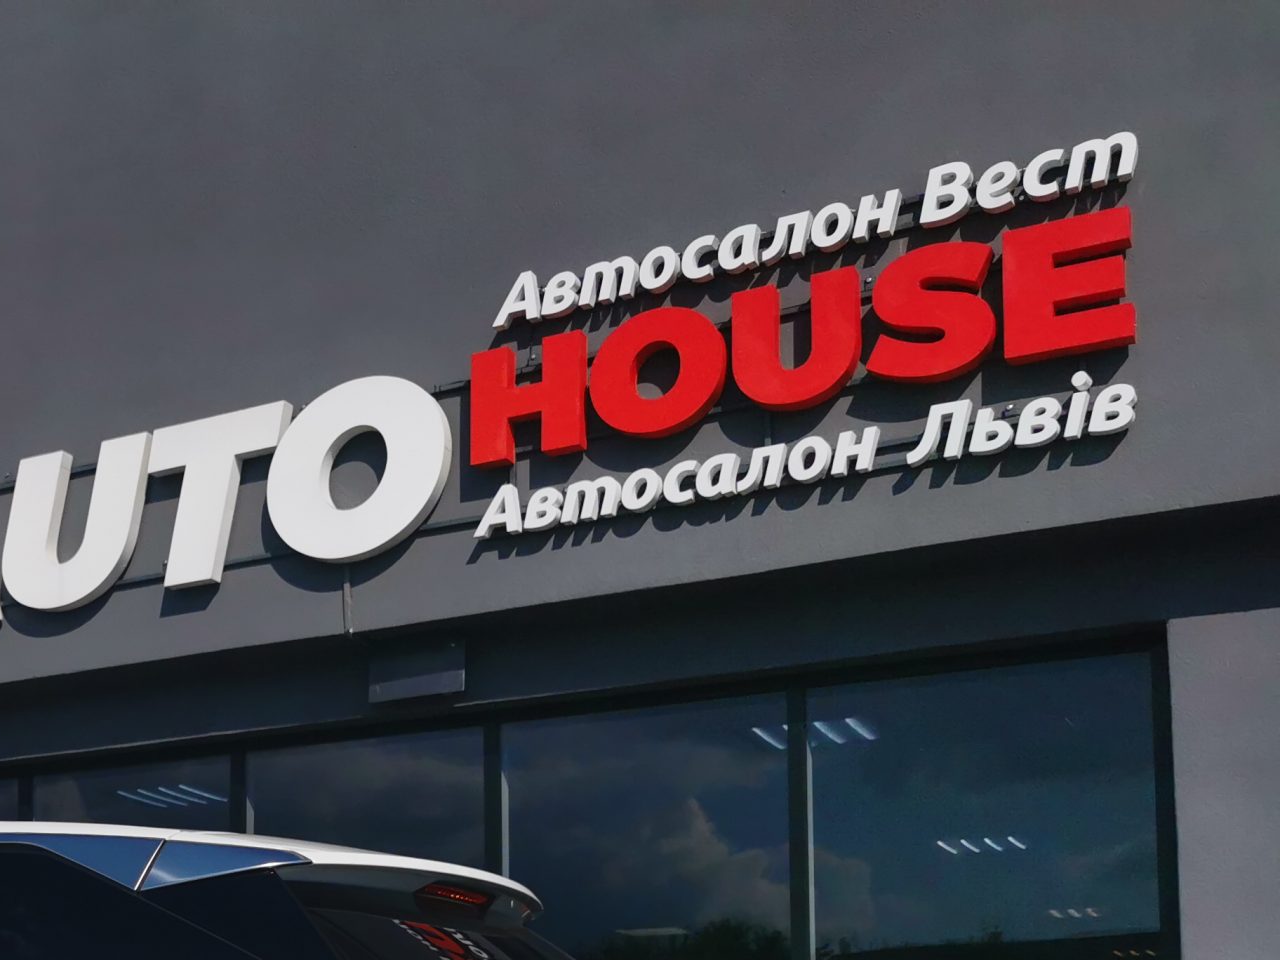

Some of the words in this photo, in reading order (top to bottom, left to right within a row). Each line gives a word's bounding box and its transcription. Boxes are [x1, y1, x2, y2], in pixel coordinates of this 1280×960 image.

[492, 188, 903, 330] Автосалон
[918, 130, 1139, 228] Вест
[468, 206, 1137, 469] HOUSE
[473, 426, 880, 538] Автосалон
[906, 370, 1138, 468] Львів
